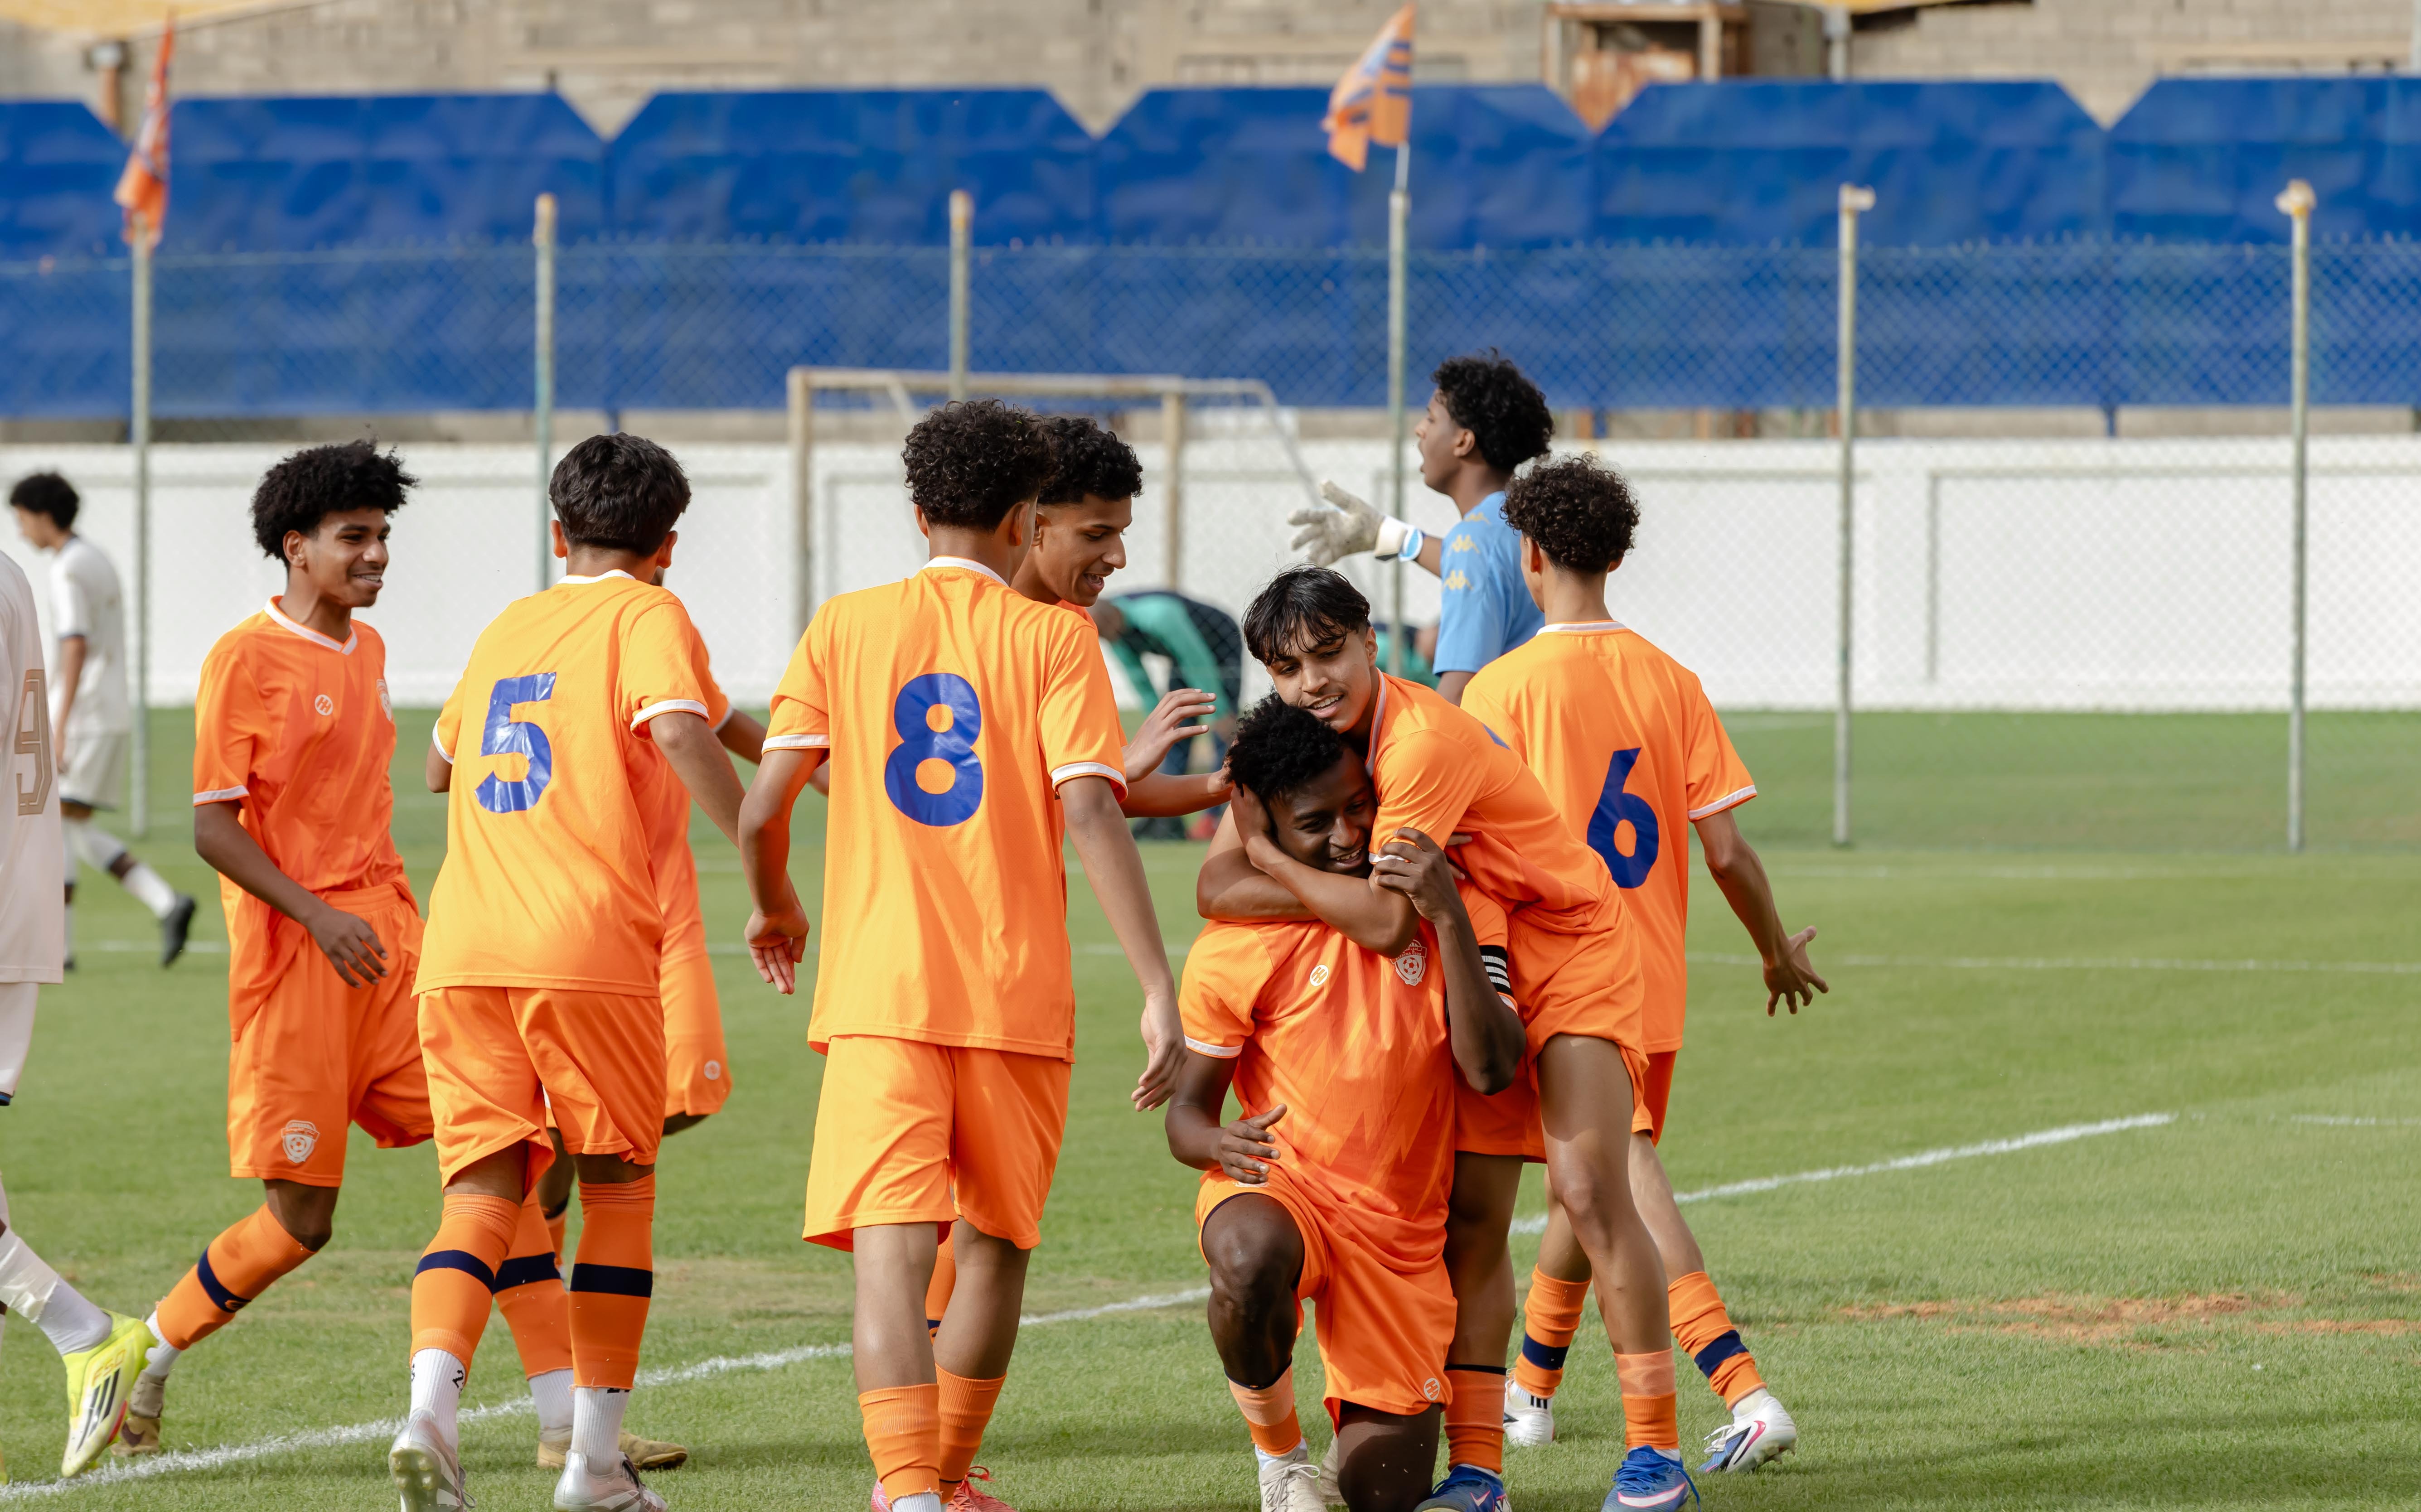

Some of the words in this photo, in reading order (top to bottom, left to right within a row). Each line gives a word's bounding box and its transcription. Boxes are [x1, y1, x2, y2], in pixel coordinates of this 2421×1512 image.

[15, 669, 52, 816] 9
[474, 671, 557, 814] 5
[884, 673, 983, 826] 8
[1587, 747, 1659, 889] 6
[92, 1349, 126, 1386] F50
